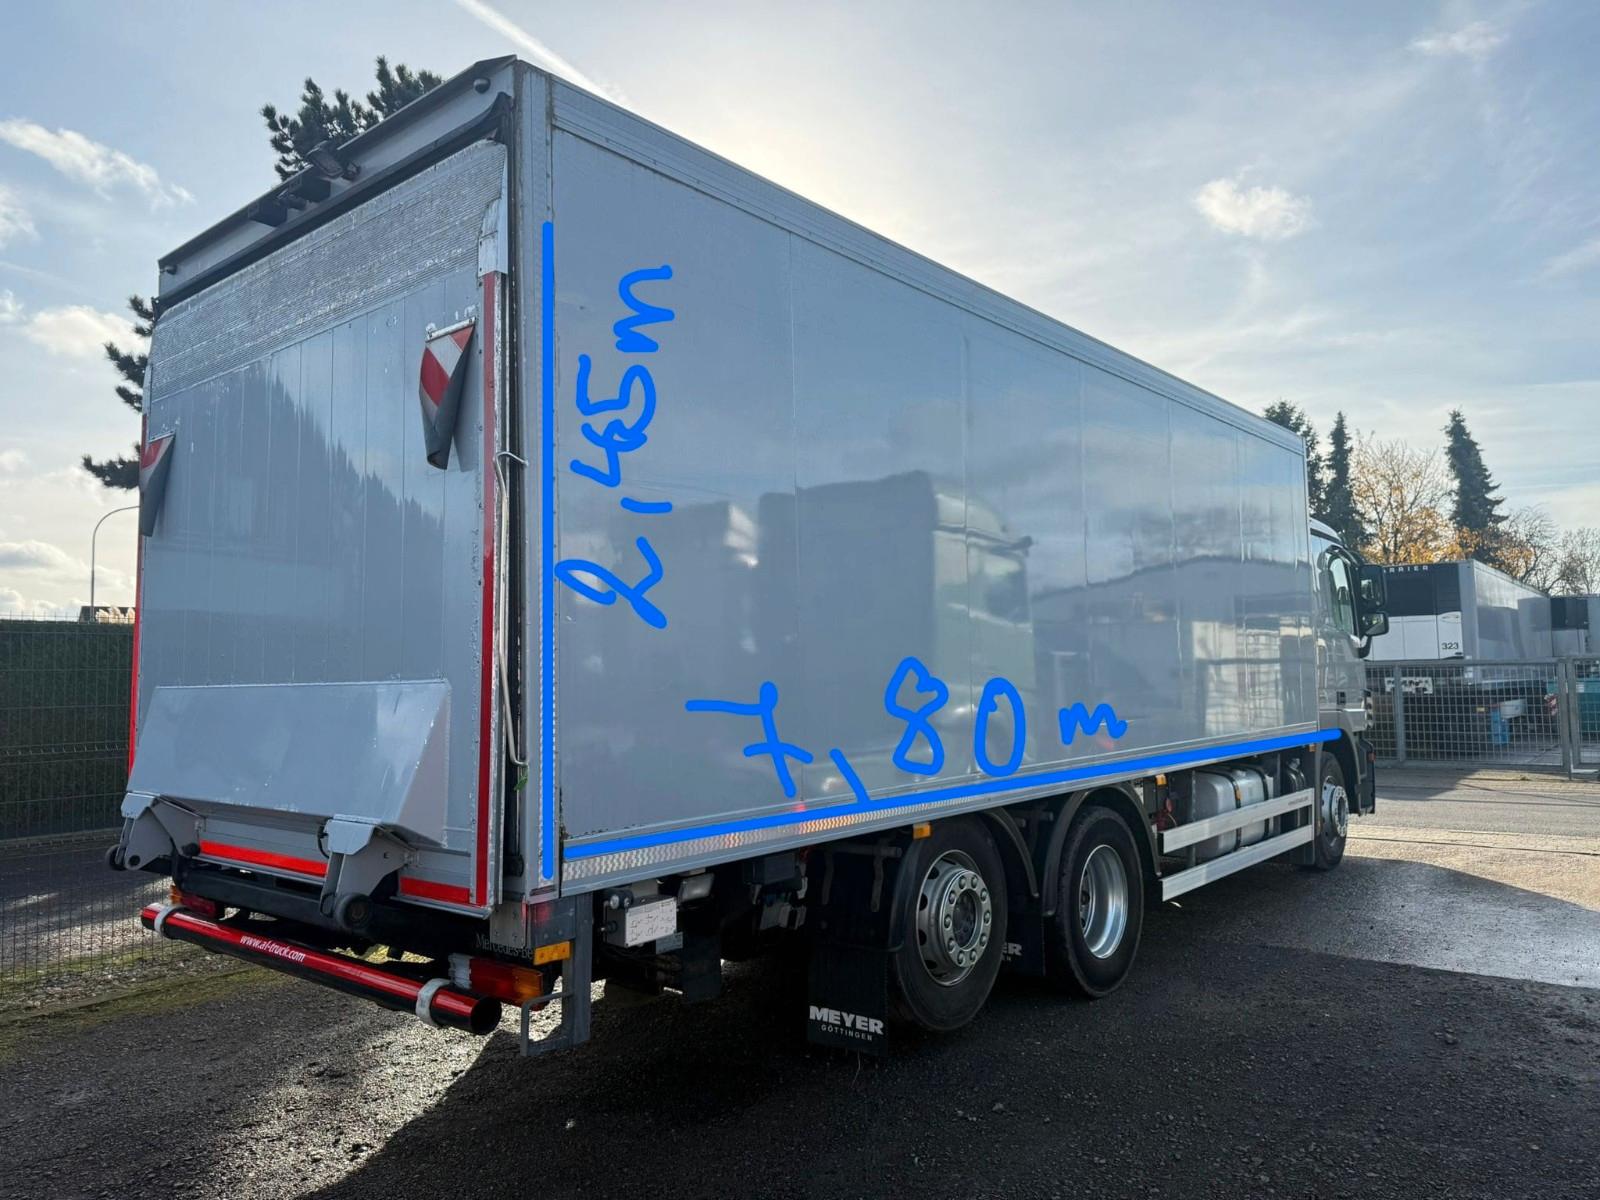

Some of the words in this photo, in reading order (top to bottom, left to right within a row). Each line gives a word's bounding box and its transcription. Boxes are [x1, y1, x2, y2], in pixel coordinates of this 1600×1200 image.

[1441, 642, 1459, 650] 323
[240, 935, 306, 962] www.al-truck.com
[475, 932, 535, 960] Mercedes-Be
[809, 1005, 884, 1035] MEYER
